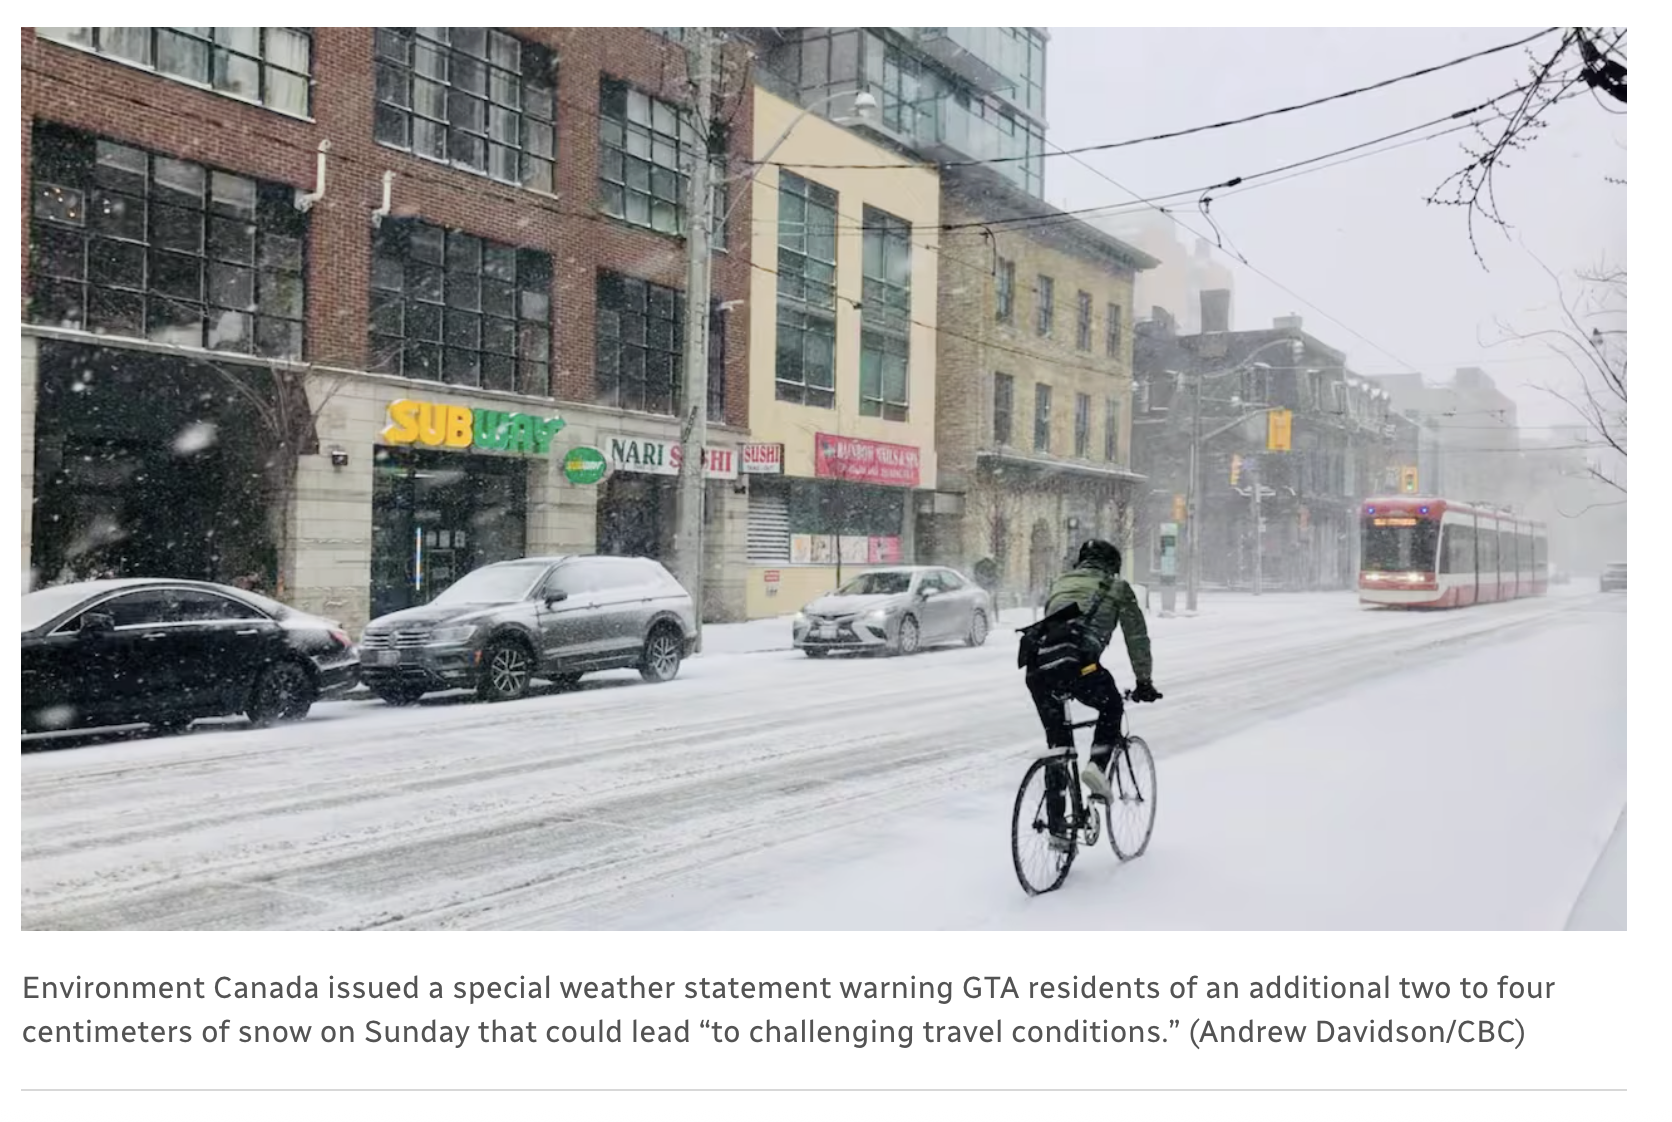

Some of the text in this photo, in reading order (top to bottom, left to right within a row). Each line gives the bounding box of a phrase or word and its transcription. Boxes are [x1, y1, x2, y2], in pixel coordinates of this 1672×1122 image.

[382, 399, 567, 453] SUBWAY
[611, 438, 664, 466] NARI
[744, 445, 780, 463] SUSHI
